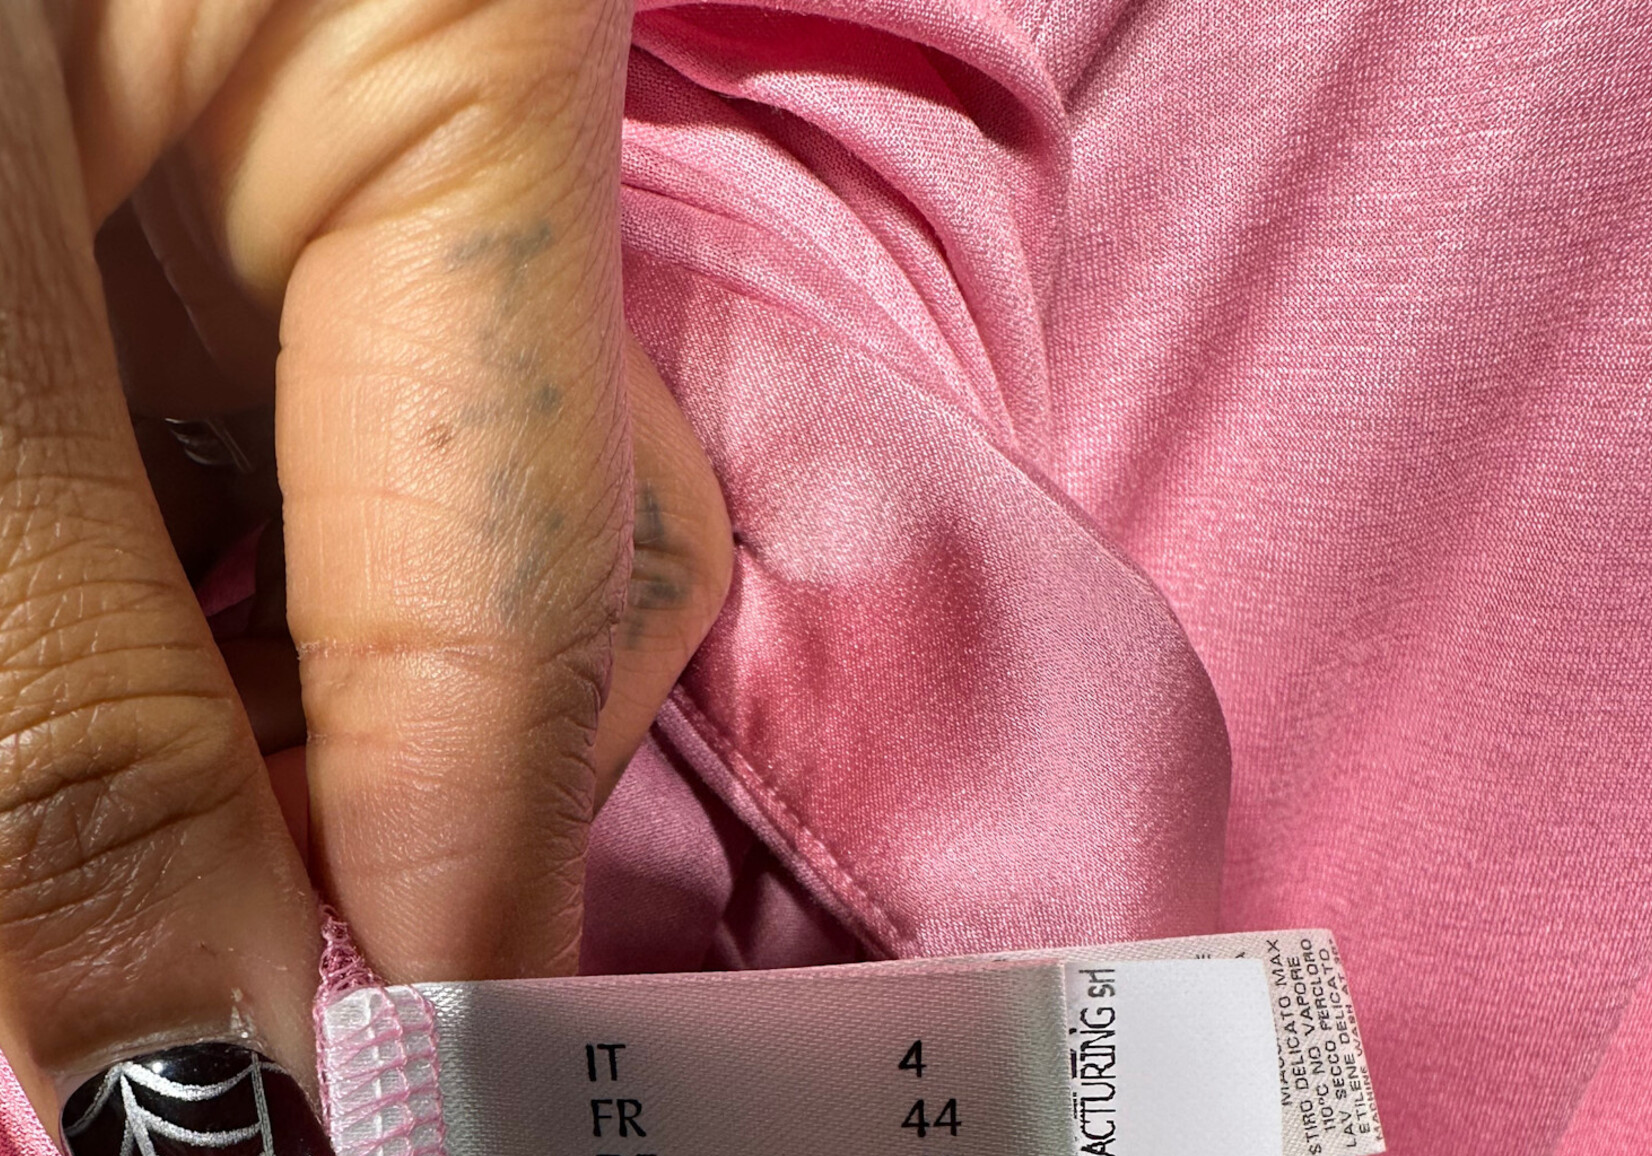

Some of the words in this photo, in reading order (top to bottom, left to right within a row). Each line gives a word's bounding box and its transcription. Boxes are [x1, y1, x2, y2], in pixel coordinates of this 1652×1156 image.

[1266, 938, 1287, 987] MAX
[1300, 938, 1332, 1031] PERCLORO
[1287, 956, 1315, 1037] VAPORE
[1319, 948, 1350, 1045] DELICATO
[585, 1043, 626, 1082] IT
[898, 1039, 928, 1079] 4
[1277, 995, 1309, 1091] DELICATO
[1308, 1046, 1326, 1074] NO
[1325, 1040, 1348, 1100] SECCO
[590, 1099, 647, 1138] FR
[901, 1098, 962, 1138] 44
[1344, 1053, 1371, 1134] ETILENE
[1299, 1100, 1322, 1155] STIRO
[1339, 1110, 1357, 1148] LAV
